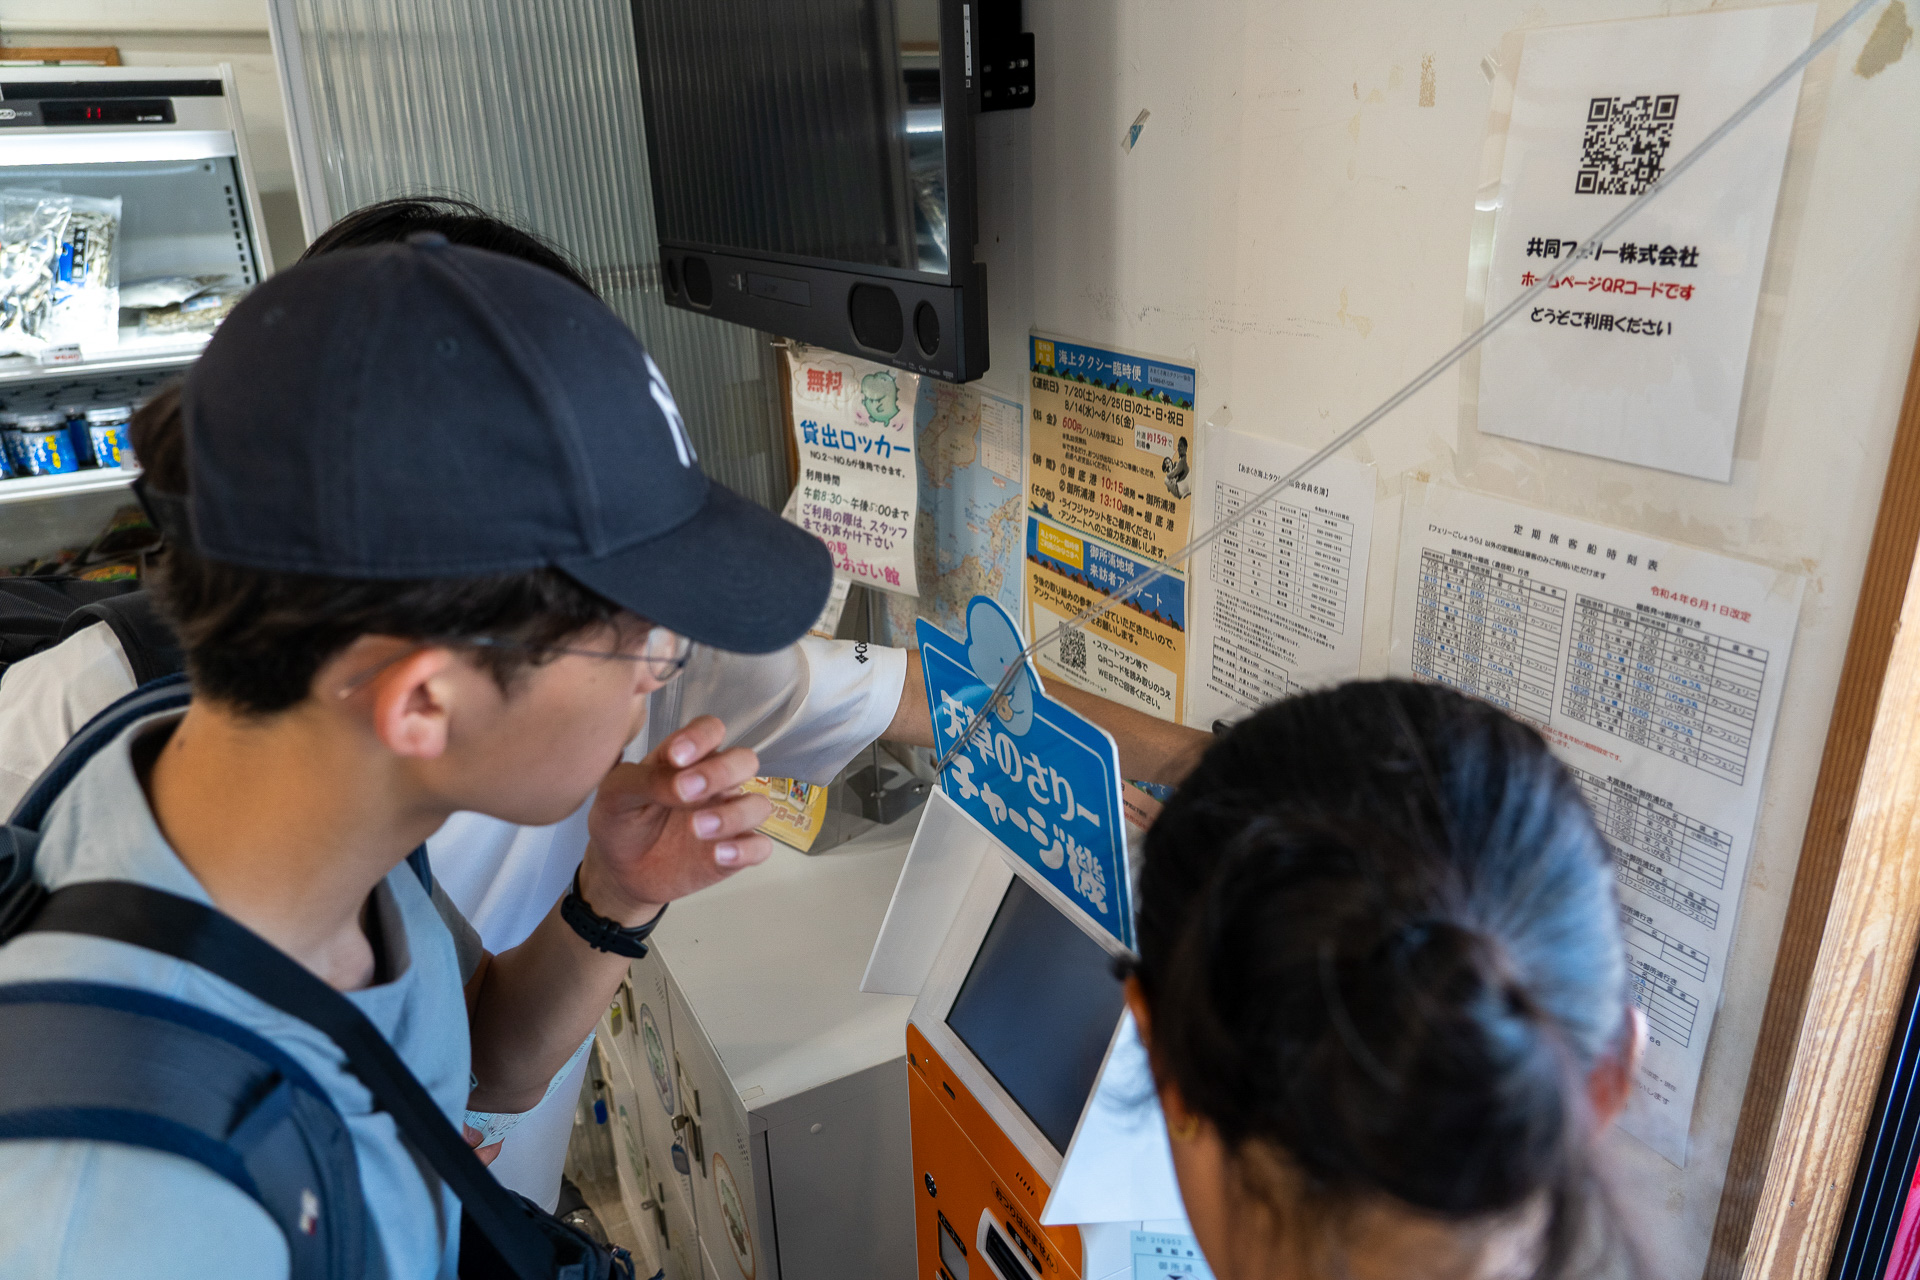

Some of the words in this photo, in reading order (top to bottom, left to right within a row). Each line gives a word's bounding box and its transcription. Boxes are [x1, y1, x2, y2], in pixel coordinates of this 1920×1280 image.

[1521, 271, 1696, 301] ホームページQRコードです
[1531, 307, 1672, 336] どうぞご利用ください
[1058, 349, 1142, 383] 海上タクシー臨時便
[806, 367, 843, 396] 無料
[800, 419, 911, 459] 貸出ロッカー
[805, 469, 841, 487] 利用時間
[802, 503, 907, 539] ご利用の際は、スタッフ
[802, 518, 894, 550] までお声かけ下さい
[831, 553, 901, 587] しおさい館
[1090, 543, 1135, 578] 御所浦地域
[1090, 563, 1163, 607] 来訪者アンケート
[1533, 601, 1560, 613] カーフェリー
[1651, 585, 1752, 624] 令和4年6月1日改定
[1531, 618, 1558, 631] カーフェリー
[1097, 653, 1172, 701] QRコードを読み取りのうえ
[1526, 659, 1553, 672] カーフェリー
[1097, 667, 1161, 710] WEBでご回答ください。
[1523, 683, 1549, 697] カーフェリー
[1714, 679, 1757, 698] カーフェリー
[1711, 698, 1753, 716] カーフェリー
[1706, 726, 1747, 745] カーフェリー
[1702, 752, 1742, 772] カーフェリー
[1675, 902, 1713, 926] カーフェリー
